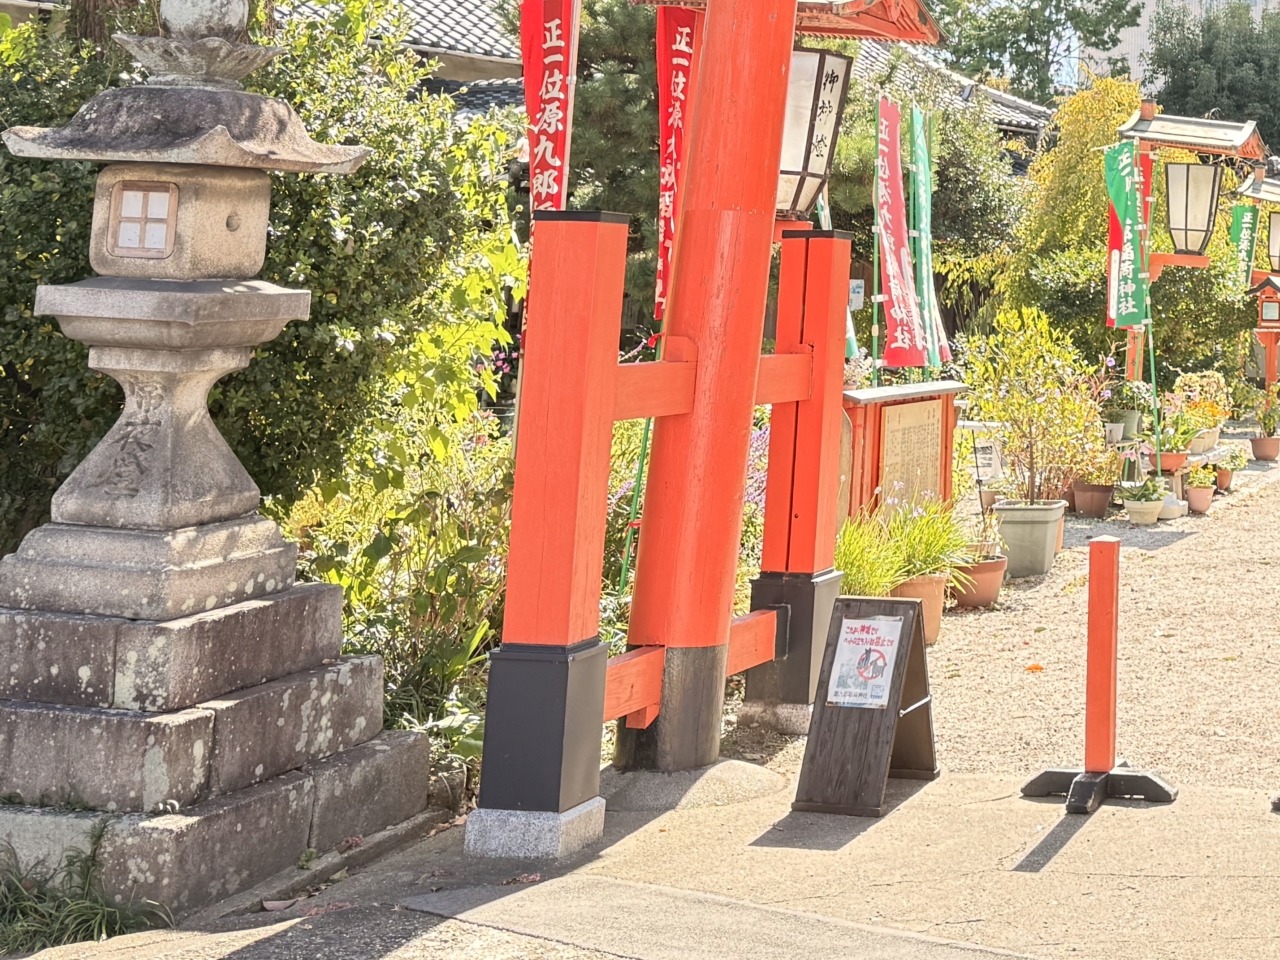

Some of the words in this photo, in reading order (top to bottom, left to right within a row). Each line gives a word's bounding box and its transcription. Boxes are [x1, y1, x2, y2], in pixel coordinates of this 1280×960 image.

[532, 18, 566, 211] 正一位源九郎
